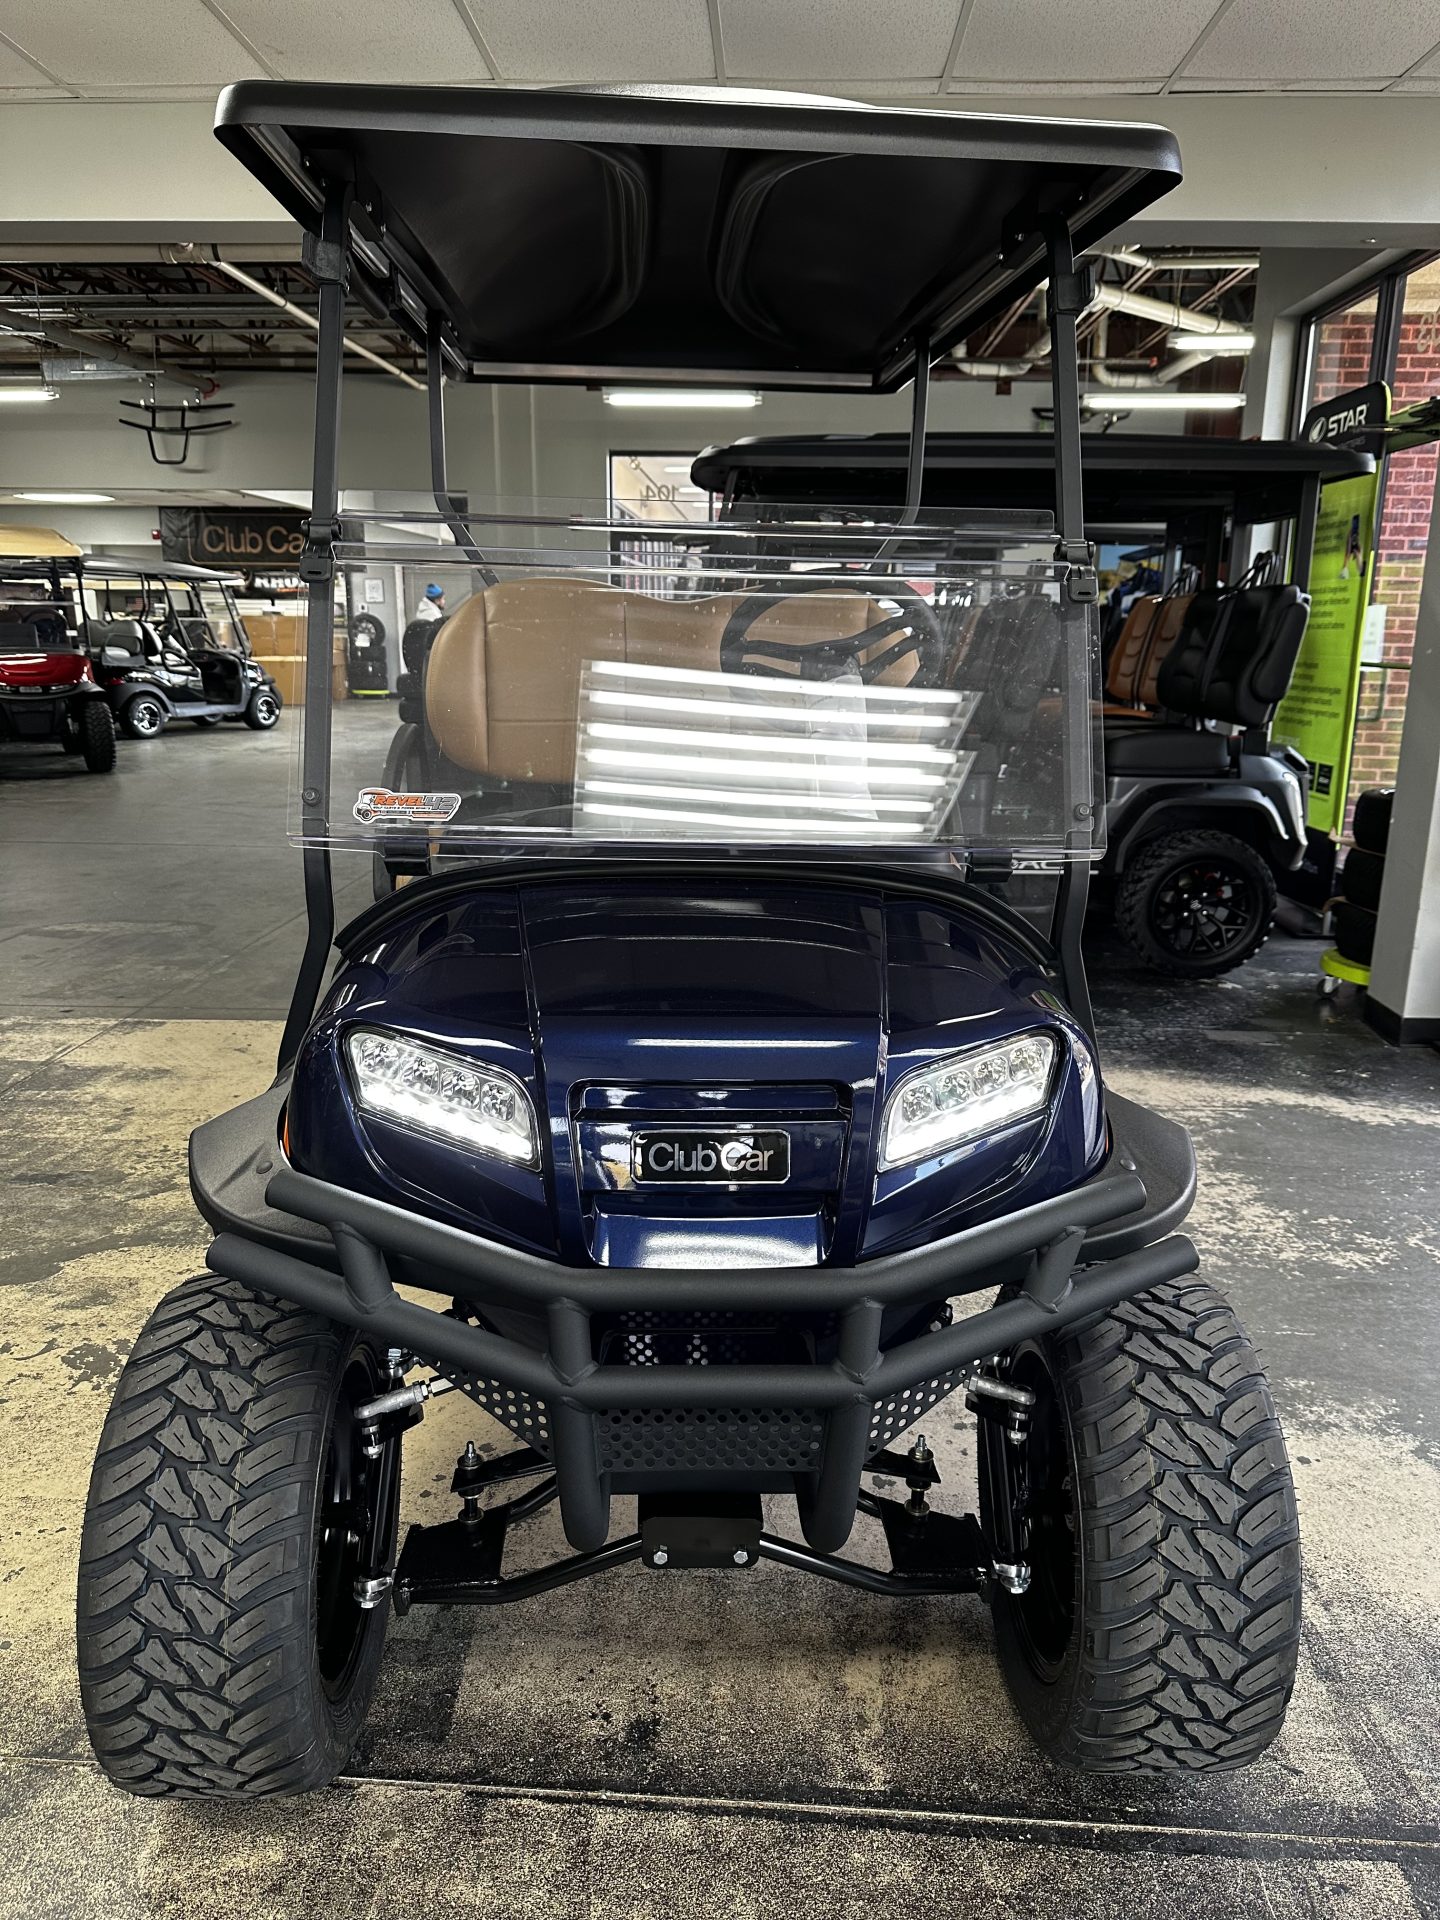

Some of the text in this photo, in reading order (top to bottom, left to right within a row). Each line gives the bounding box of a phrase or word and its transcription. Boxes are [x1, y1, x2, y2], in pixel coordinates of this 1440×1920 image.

[1327, 404, 1367, 438] STAR
[203, 526, 305, 554] Club Ca
[649, 1142, 774, 1172] Club Car
